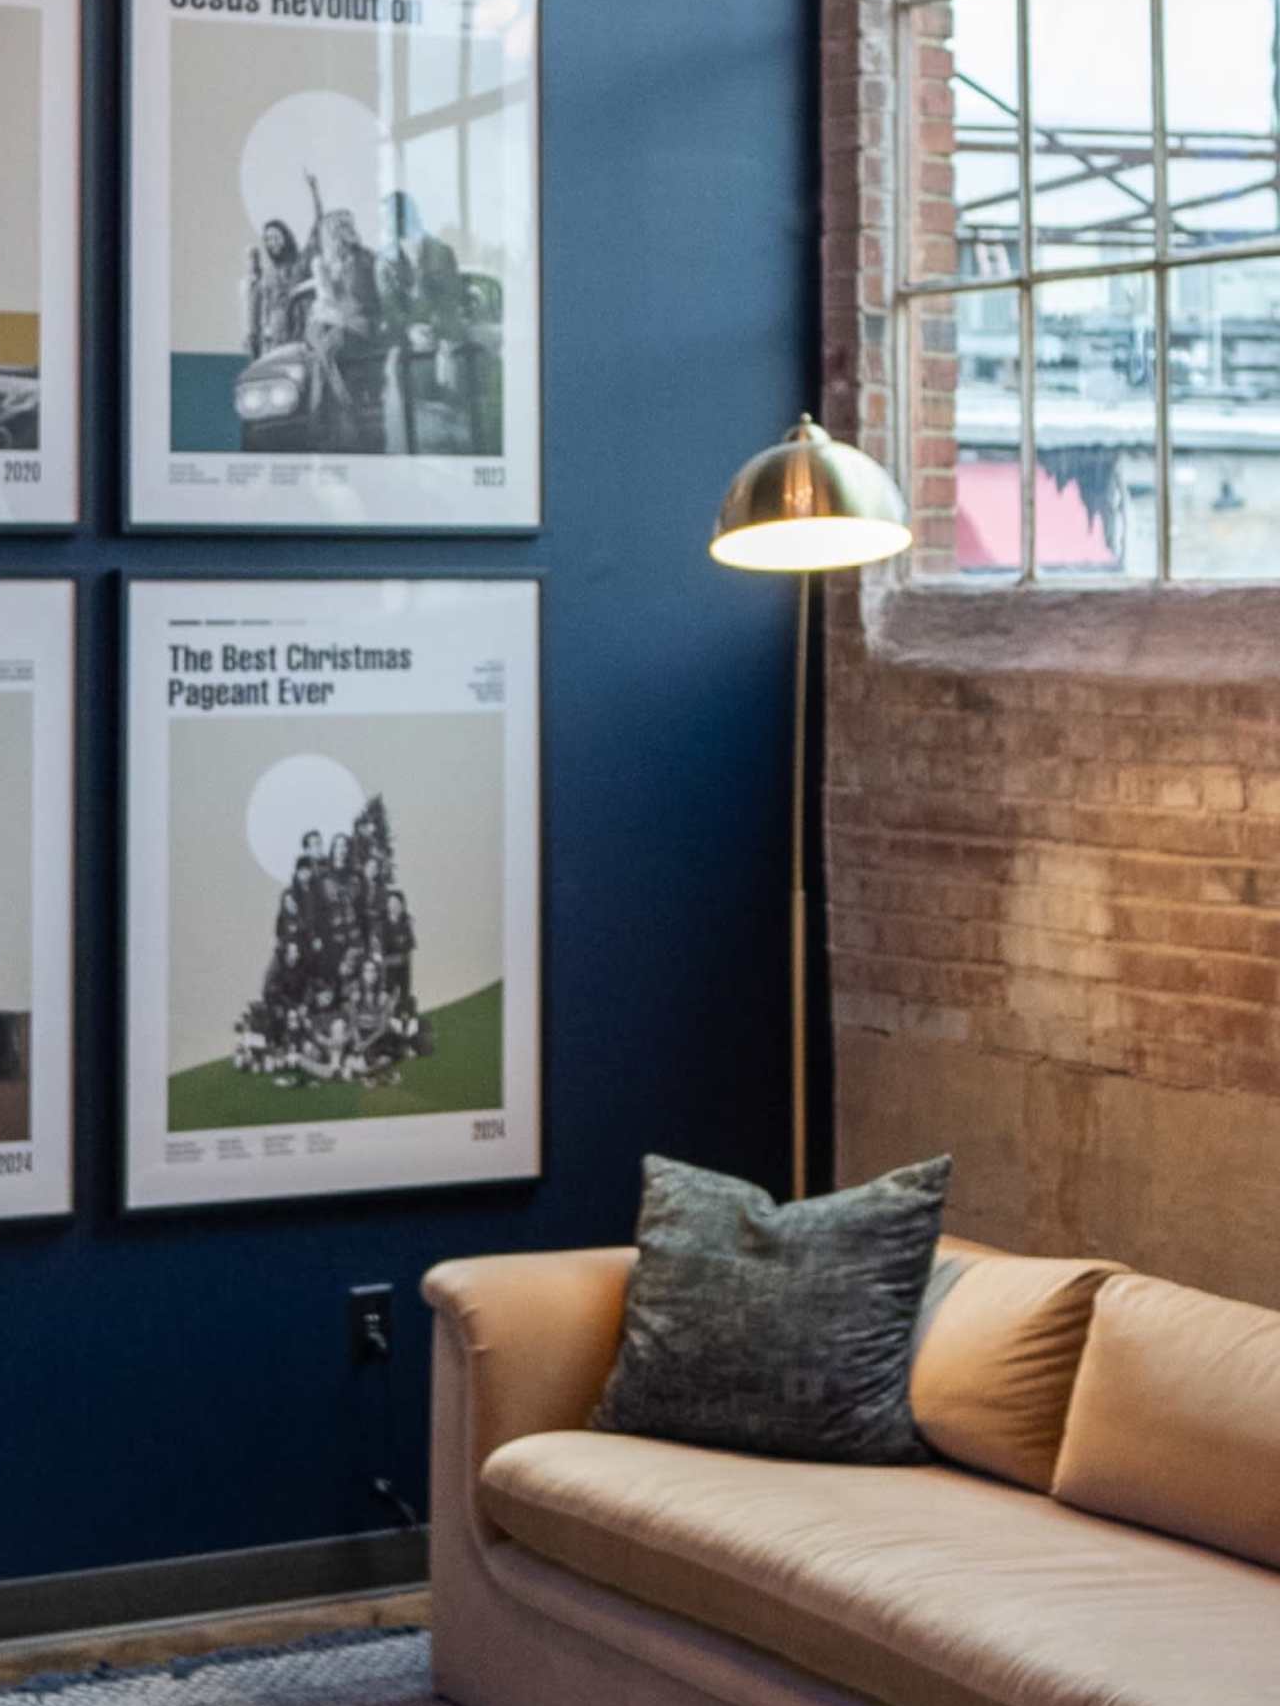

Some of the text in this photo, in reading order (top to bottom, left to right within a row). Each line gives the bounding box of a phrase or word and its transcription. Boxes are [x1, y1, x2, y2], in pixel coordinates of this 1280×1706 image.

[4, 459, 41, 484] 2020
[170, 643, 413, 673] The Best Christmas
[168, 677, 335, 711] Pageant Ever
